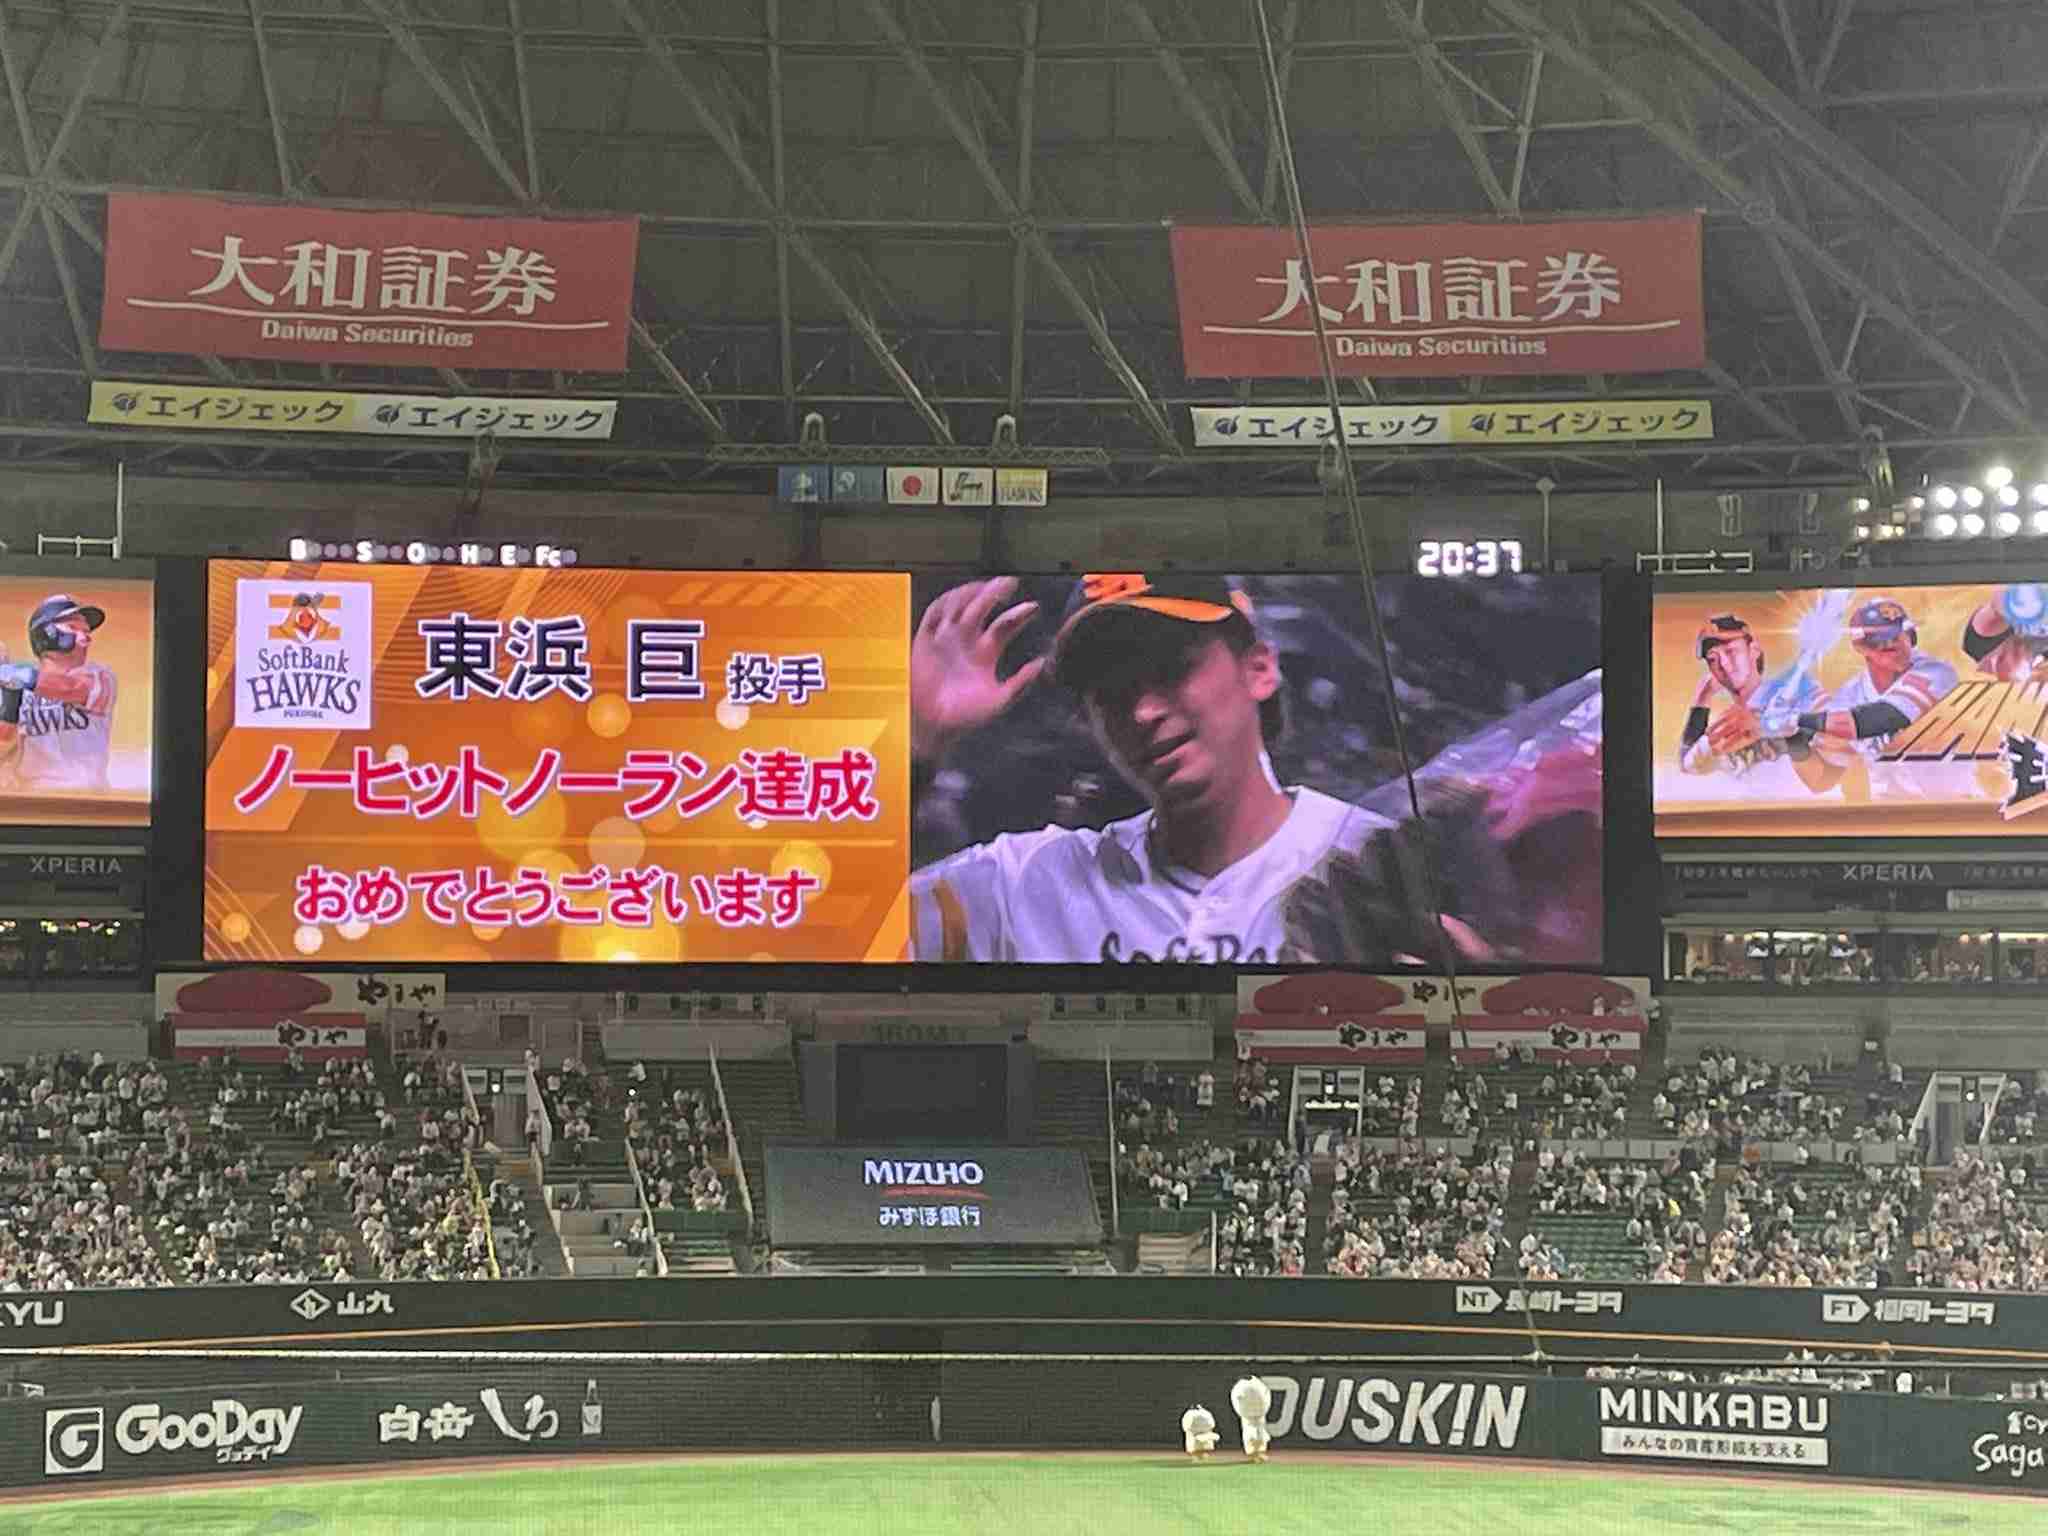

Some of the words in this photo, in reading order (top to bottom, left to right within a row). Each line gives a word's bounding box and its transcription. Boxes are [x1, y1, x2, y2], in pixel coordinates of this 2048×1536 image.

[188, 234, 559, 316] 大和証券
[1256, 251, 1622, 324] 大和証券
[261, 319, 338, 343] Daiwa
[344, 321, 473, 348] Securities
[1336, 335, 1412, 359] Daiwa
[1419, 335, 1547, 358] Securities
[146, 395, 345, 424] エイジェック
[408, 405, 604, 433] エイジェック
[1506, 409, 1700, 436] エイジェック
[1248, 413, 1439, 440] エイジェック
[1417, 541, 1521, 577] 20:37
[258, 644, 350, 674] SoftBank
[416, 613, 592, 701] 東浜
[629, 619, 705, 701] 巨
[727, 653, 827, 705] 投手
[246, 671, 361, 714] HAWKS
[234, 745, 879, 820] ノーヒットノーラン達成
[30, 856, 122, 873] XPERIA
[1843, 864, 1934, 881] XPERIA
[295, 865, 820, 926] おめでとうございます
[863, 1160, 984, 1186] MIZUHO
[878, 1206, 981, 1227] みずほ銀行
[0, 1300, 64, 1326] YU
[337, 1290, 394, 1315] 山九
[1600, 1387, 1828, 1432] MINKABU
[115, 1399, 303, 1455] GooDay
[1972, 1432, 2045, 1477] Saga
